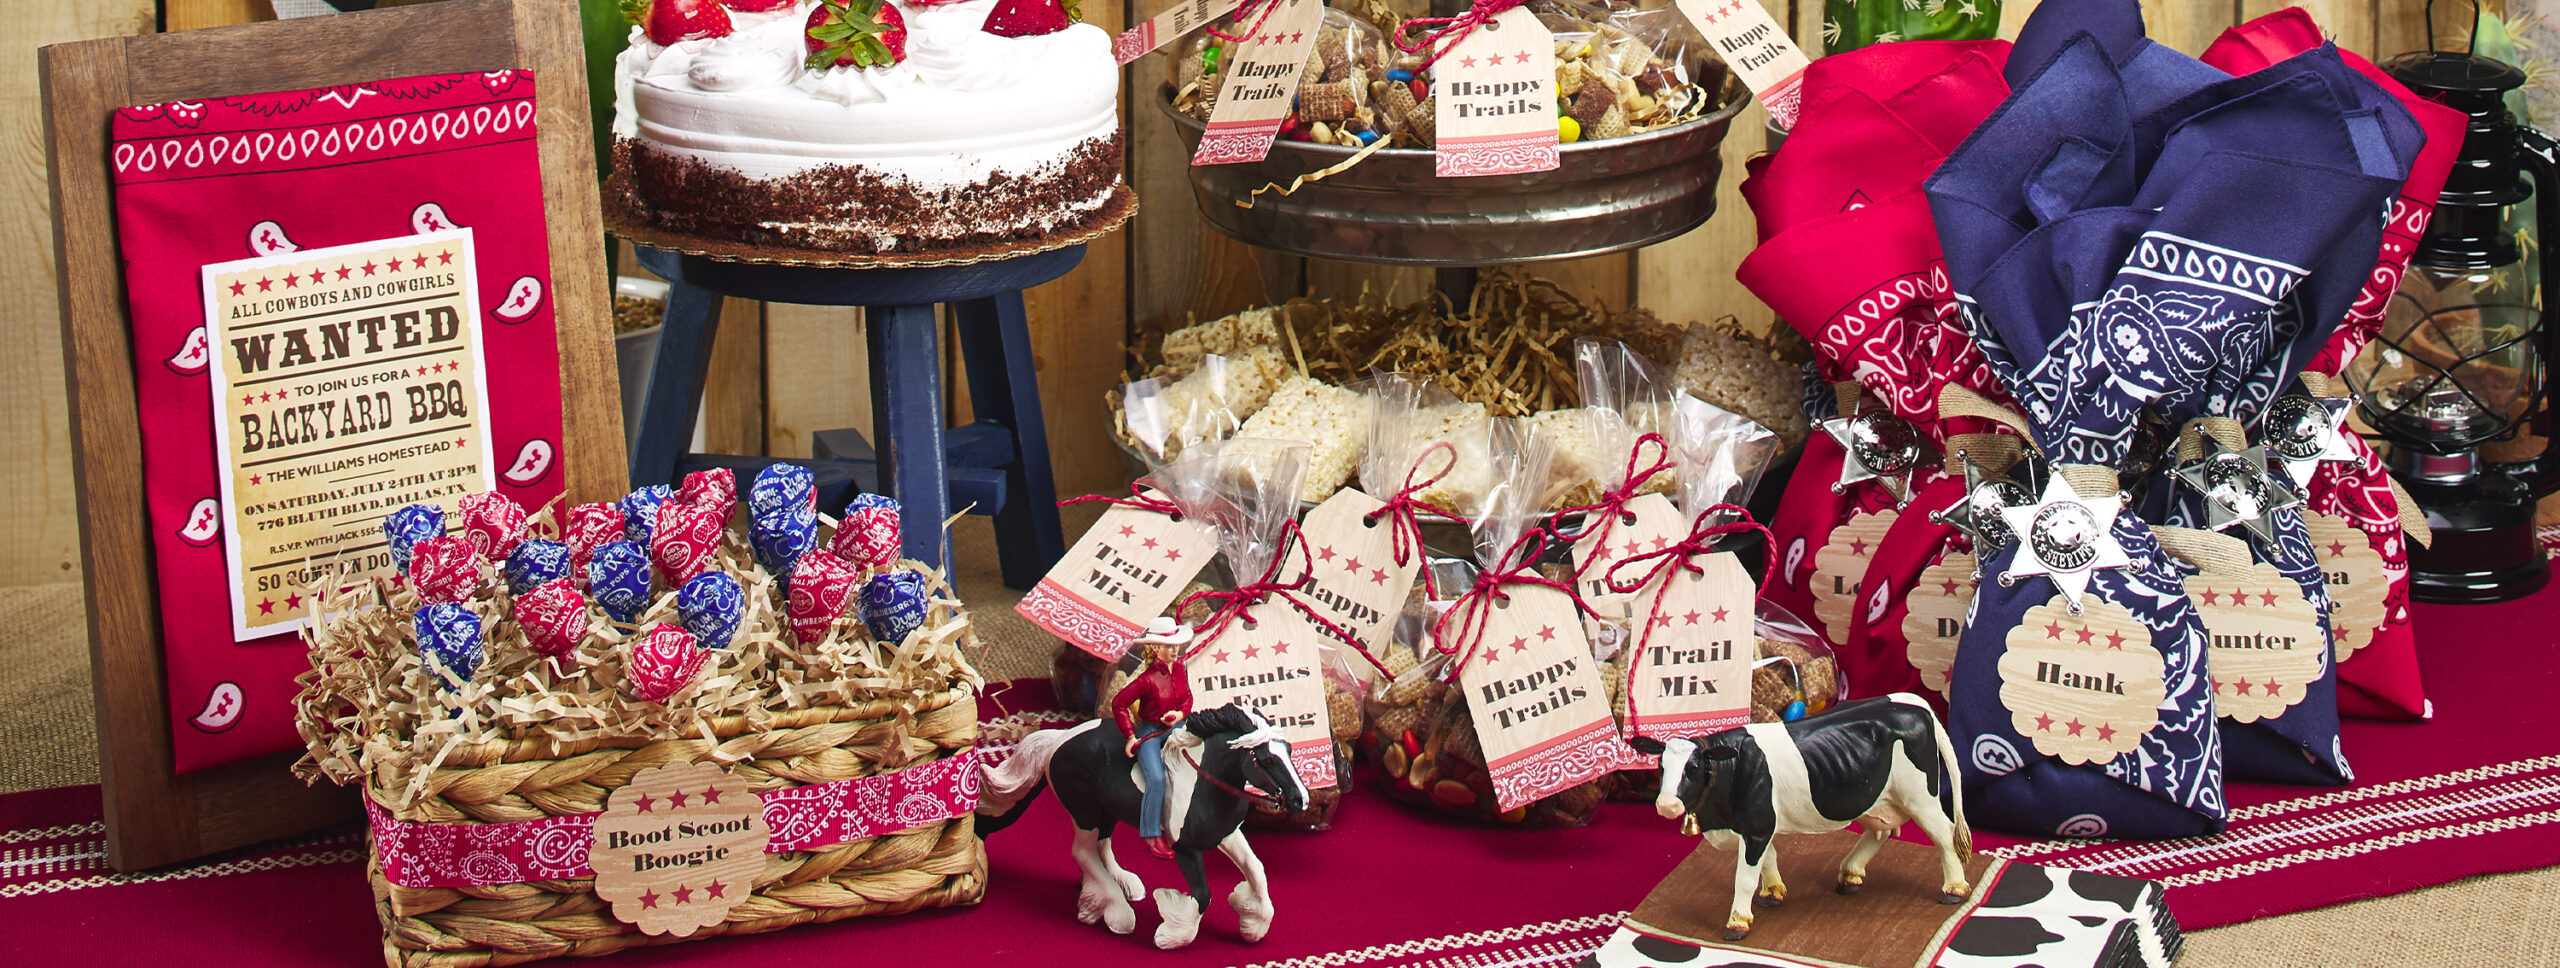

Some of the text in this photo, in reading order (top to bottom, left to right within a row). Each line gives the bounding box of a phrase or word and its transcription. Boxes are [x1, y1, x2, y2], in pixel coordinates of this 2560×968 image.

[1720, 21, 1770, 53] Happy
[1238, 61, 1298, 79] Happy
[1738, 43, 1787, 71] Trails
[1232, 83, 1285, 101] Trails
[1451, 79, 1543, 96] Happy
[1454, 99, 1541, 117] Trails
[232, 273, 455, 319] ALL COWBOYS AND COWGIRLS
[231, 305, 459, 374] WANTED
[295, 369, 410, 397] TO JOIN US FOR A
[240, 379, 467, 453] BACKYARD BBQ
[267, 441, 450, 482] THE WILLIAMS HOMESTEAD
[244, 505, 265, 516] ON
[351, 481, 385, 497] JULY
[388, 474, 425, 489] 24TH
[427, 470, 445, 481] AT
[448, 464, 477, 478] 3PM
[257, 518, 284, 531] 776
[288, 507, 337, 526] BLUTH
[447, 482, 467, 495] TX
[270, 543, 302, 554] R.S.V.P.
[305, 536, 333, 548] WITH
[335, 532, 359, 543] JACK
[361, 525, 384, 536] 555-0
[258, 574, 280, 592] SO
[367, 552, 390, 571] DO
[1095, 542, 1168, 589] Trail
[1082, 568, 1136, 605] Mix
[1296, 572, 1385, 627] Happy
[447, 625, 475, 653] DUMS
[1648, 640, 1732, 666] Trail
[1198, 667, 1311, 691] Thanks
[1481, 656, 1578, 705] Happy
[1658, 676, 1718, 698] Mix
[2037, 661, 2127, 695] Hank
[1233, 694, 1283, 708] For
[1493, 684, 1587, 730] Trails
[1268, 712, 1317, 729] ing
[608, 814, 752, 849] Boot Scoot
[633, 845, 729, 873] Boogie
